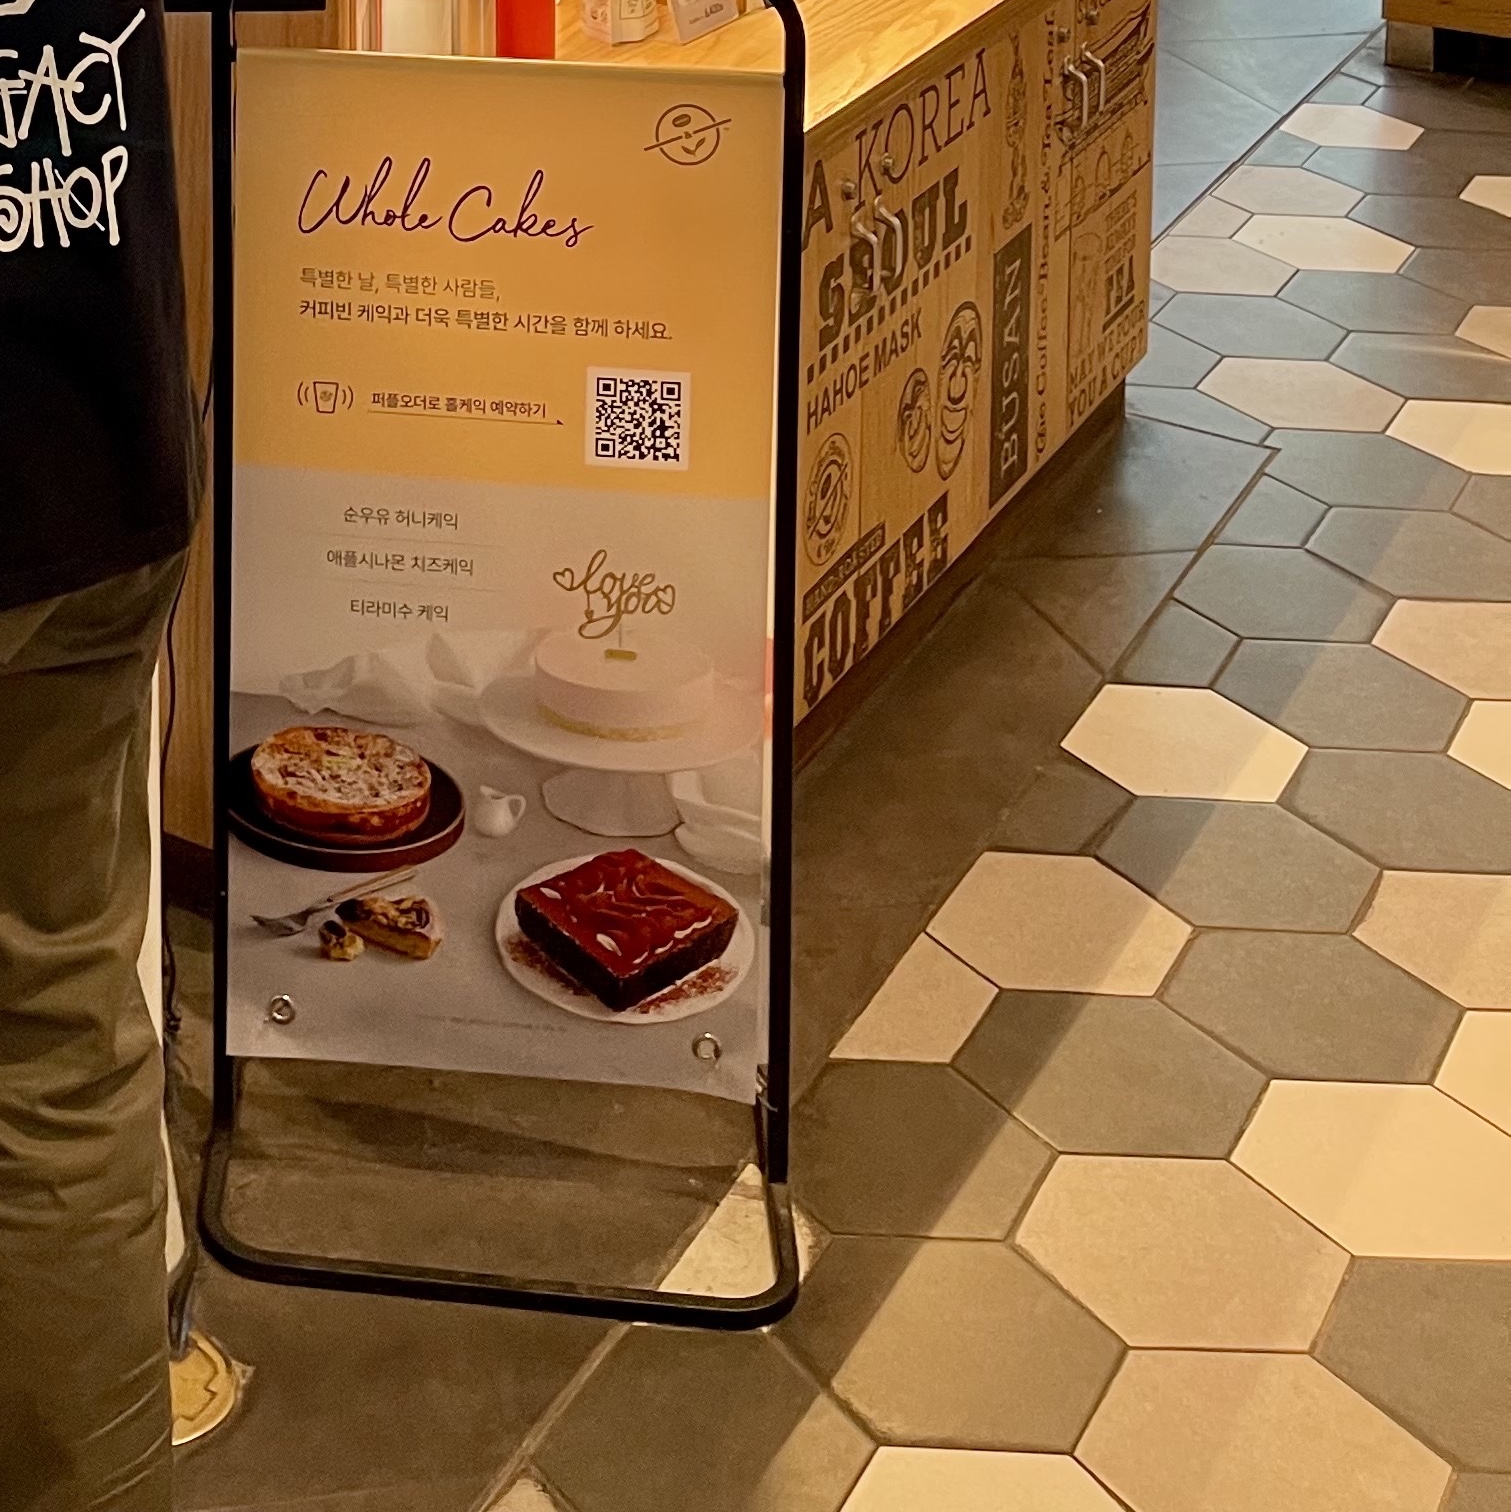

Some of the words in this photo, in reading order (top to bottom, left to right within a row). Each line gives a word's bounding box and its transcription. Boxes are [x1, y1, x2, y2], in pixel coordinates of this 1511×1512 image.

[854, 47, 992, 212] KOREA
[297, 155, 444, 234] Whole
[448, 168, 595, 249] Cakes
[299, 266, 353, 289] 특별한
[357, 270, 380, 295] 날,
[385, 273, 438, 296] 특별한
[442, 278, 502, 302] 사람들,
[818, 166, 969, 353] SEOUL
[299, 299, 353, 321] 커피빈
[356, 303, 410, 325] 케익과
[414, 307, 451, 328] 더욱
[454, 308, 508, 333] 특별한
[513, 313, 568, 336] 시간을
[572, 316, 609, 338] 함께
[613, 319, 674, 341] 하세요.
[1036, 297, 1049, 395] Coffee
[806, 362, 870, 437] HAHOE
[873, 308, 923, 380] MASK
[1000, 257, 1023, 480] BUSAN
[1069, 374, 1097, 427] YOU
[1098, 365, 1109, 398] A
[371, 391, 441, 411] 퍼플오더로
[445, 396, 487, 415] 홀케익
[489, 400, 546, 419] 예약하기
[343, 506, 390, 526] 순우유
[395, 509, 459, 531] 허니케익
[326, 548, 406, 573] 애플시나몬
[410, 554, 474, 577] 치즈케익
[583, 549, 655, 596] love
[350, 598, 413, 620] 티라미수
[417, 603, 450, 622] 케익
[802, 489, 949, 709] COFFEE
